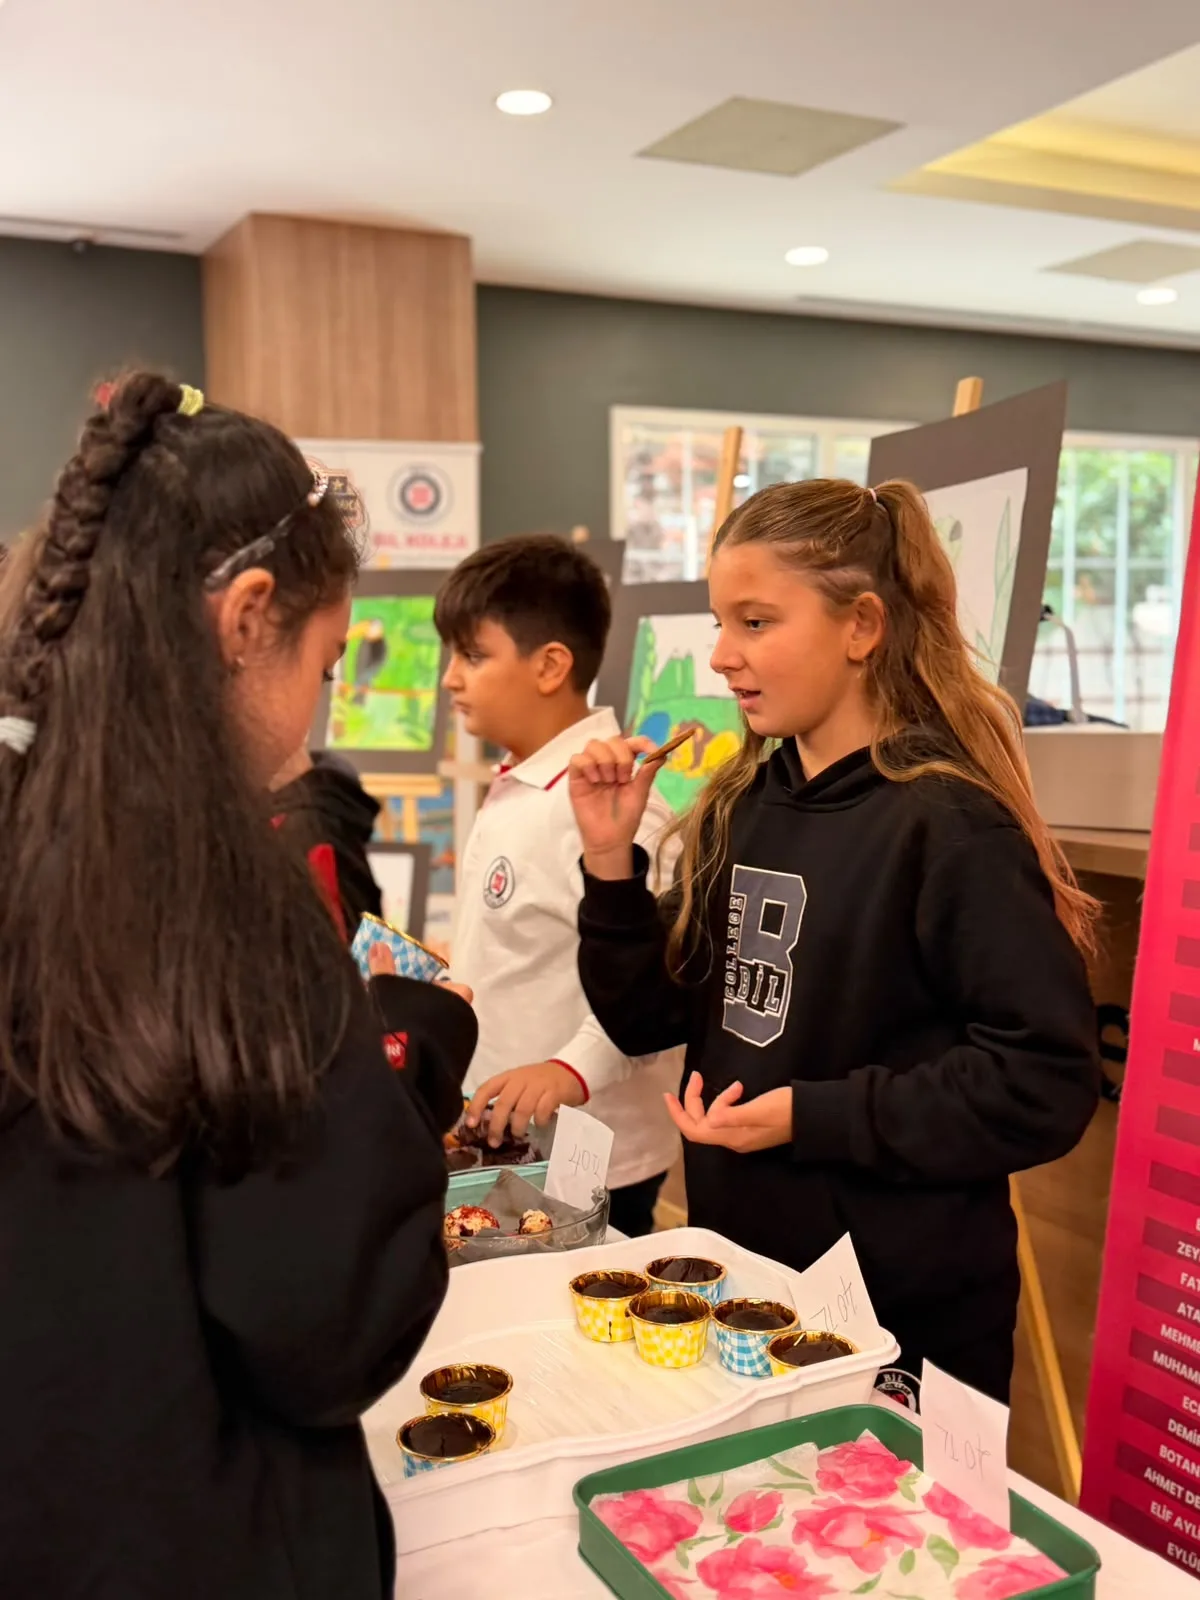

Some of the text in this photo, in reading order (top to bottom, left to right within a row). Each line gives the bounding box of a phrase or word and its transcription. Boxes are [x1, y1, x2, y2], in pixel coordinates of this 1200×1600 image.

[1177, 1241, 1200, 1262] ZEY
[1153, 1350, 1200, 1385] MUHAM
[1144, 1467, 1184, 1499] AHMET
[1151, 1501, 1173, 1522] ELİF
